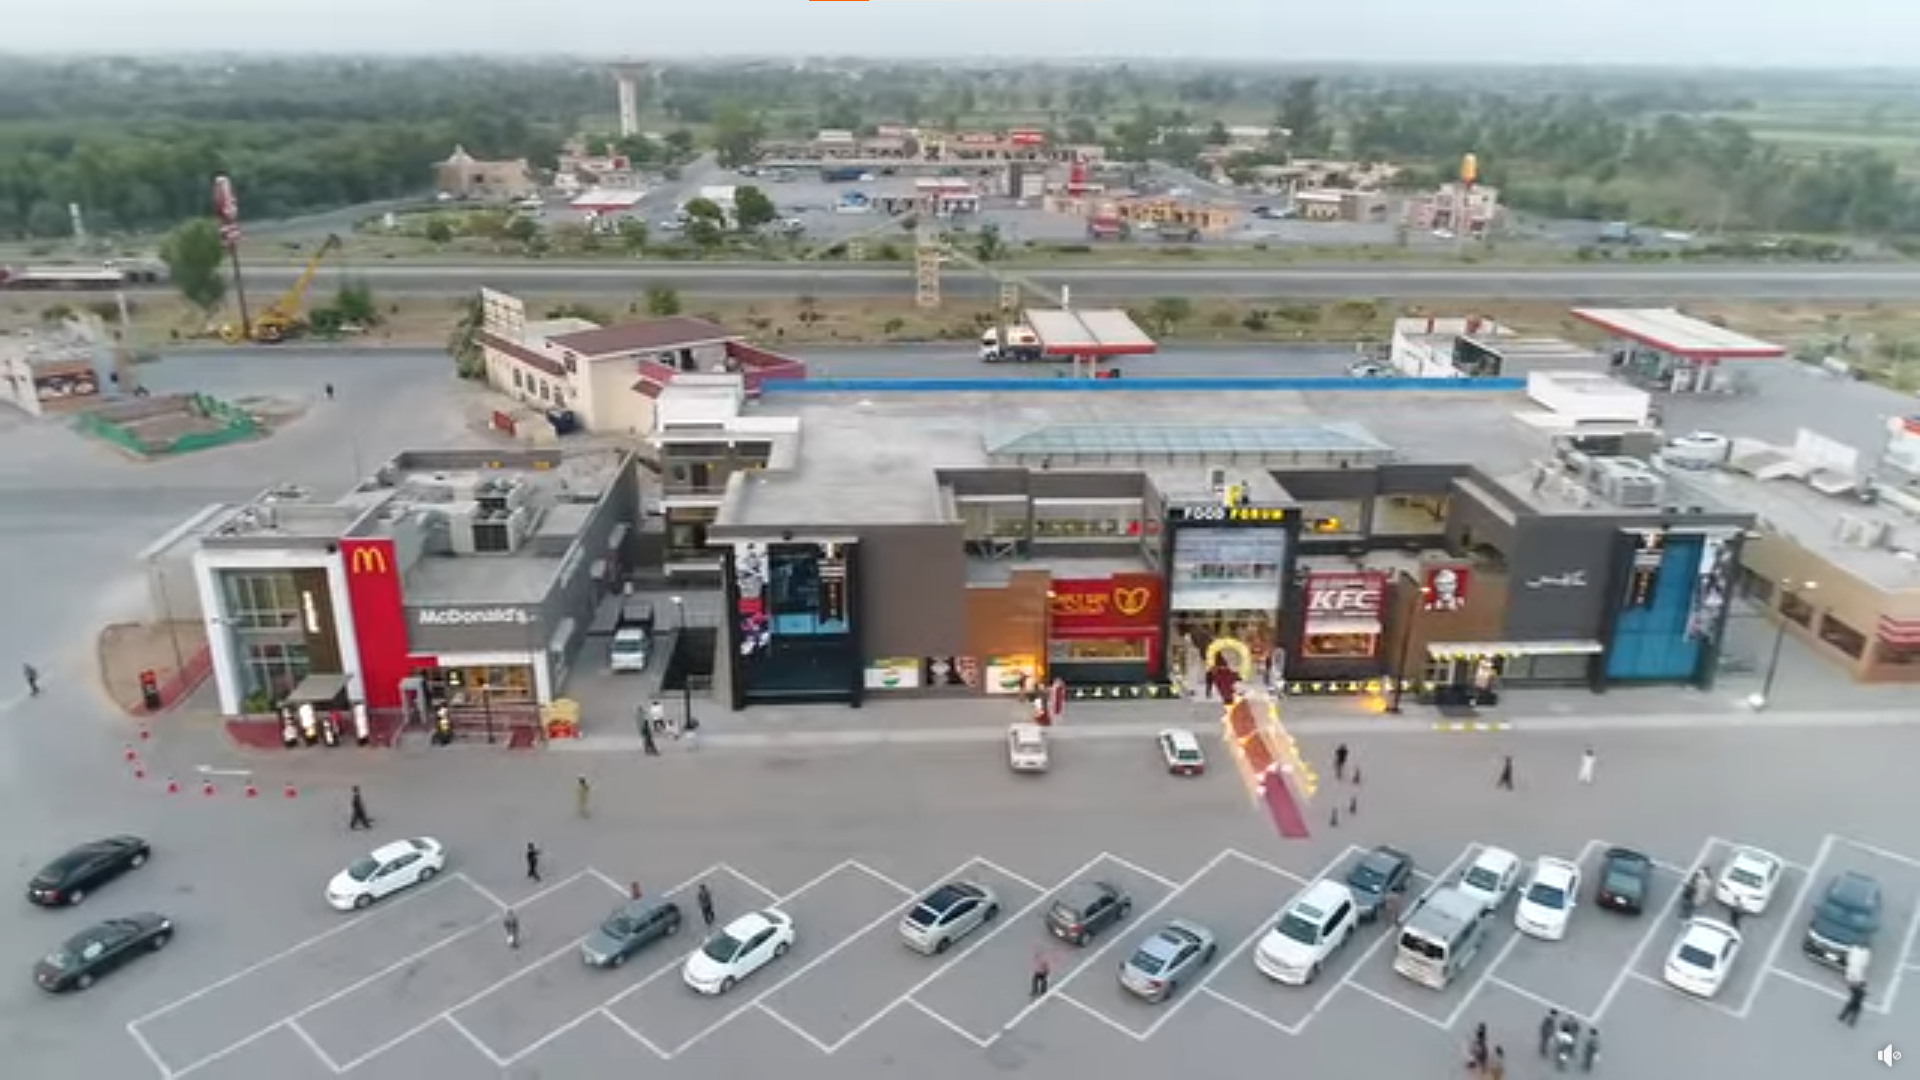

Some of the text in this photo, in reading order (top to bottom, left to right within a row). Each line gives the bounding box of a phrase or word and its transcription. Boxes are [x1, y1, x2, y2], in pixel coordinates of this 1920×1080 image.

[1184, 507, 1284, 520] FOOD FORUM
[1307, 589, 1382, 610] KFC
[419, 607, 529, 625] McDonald's
